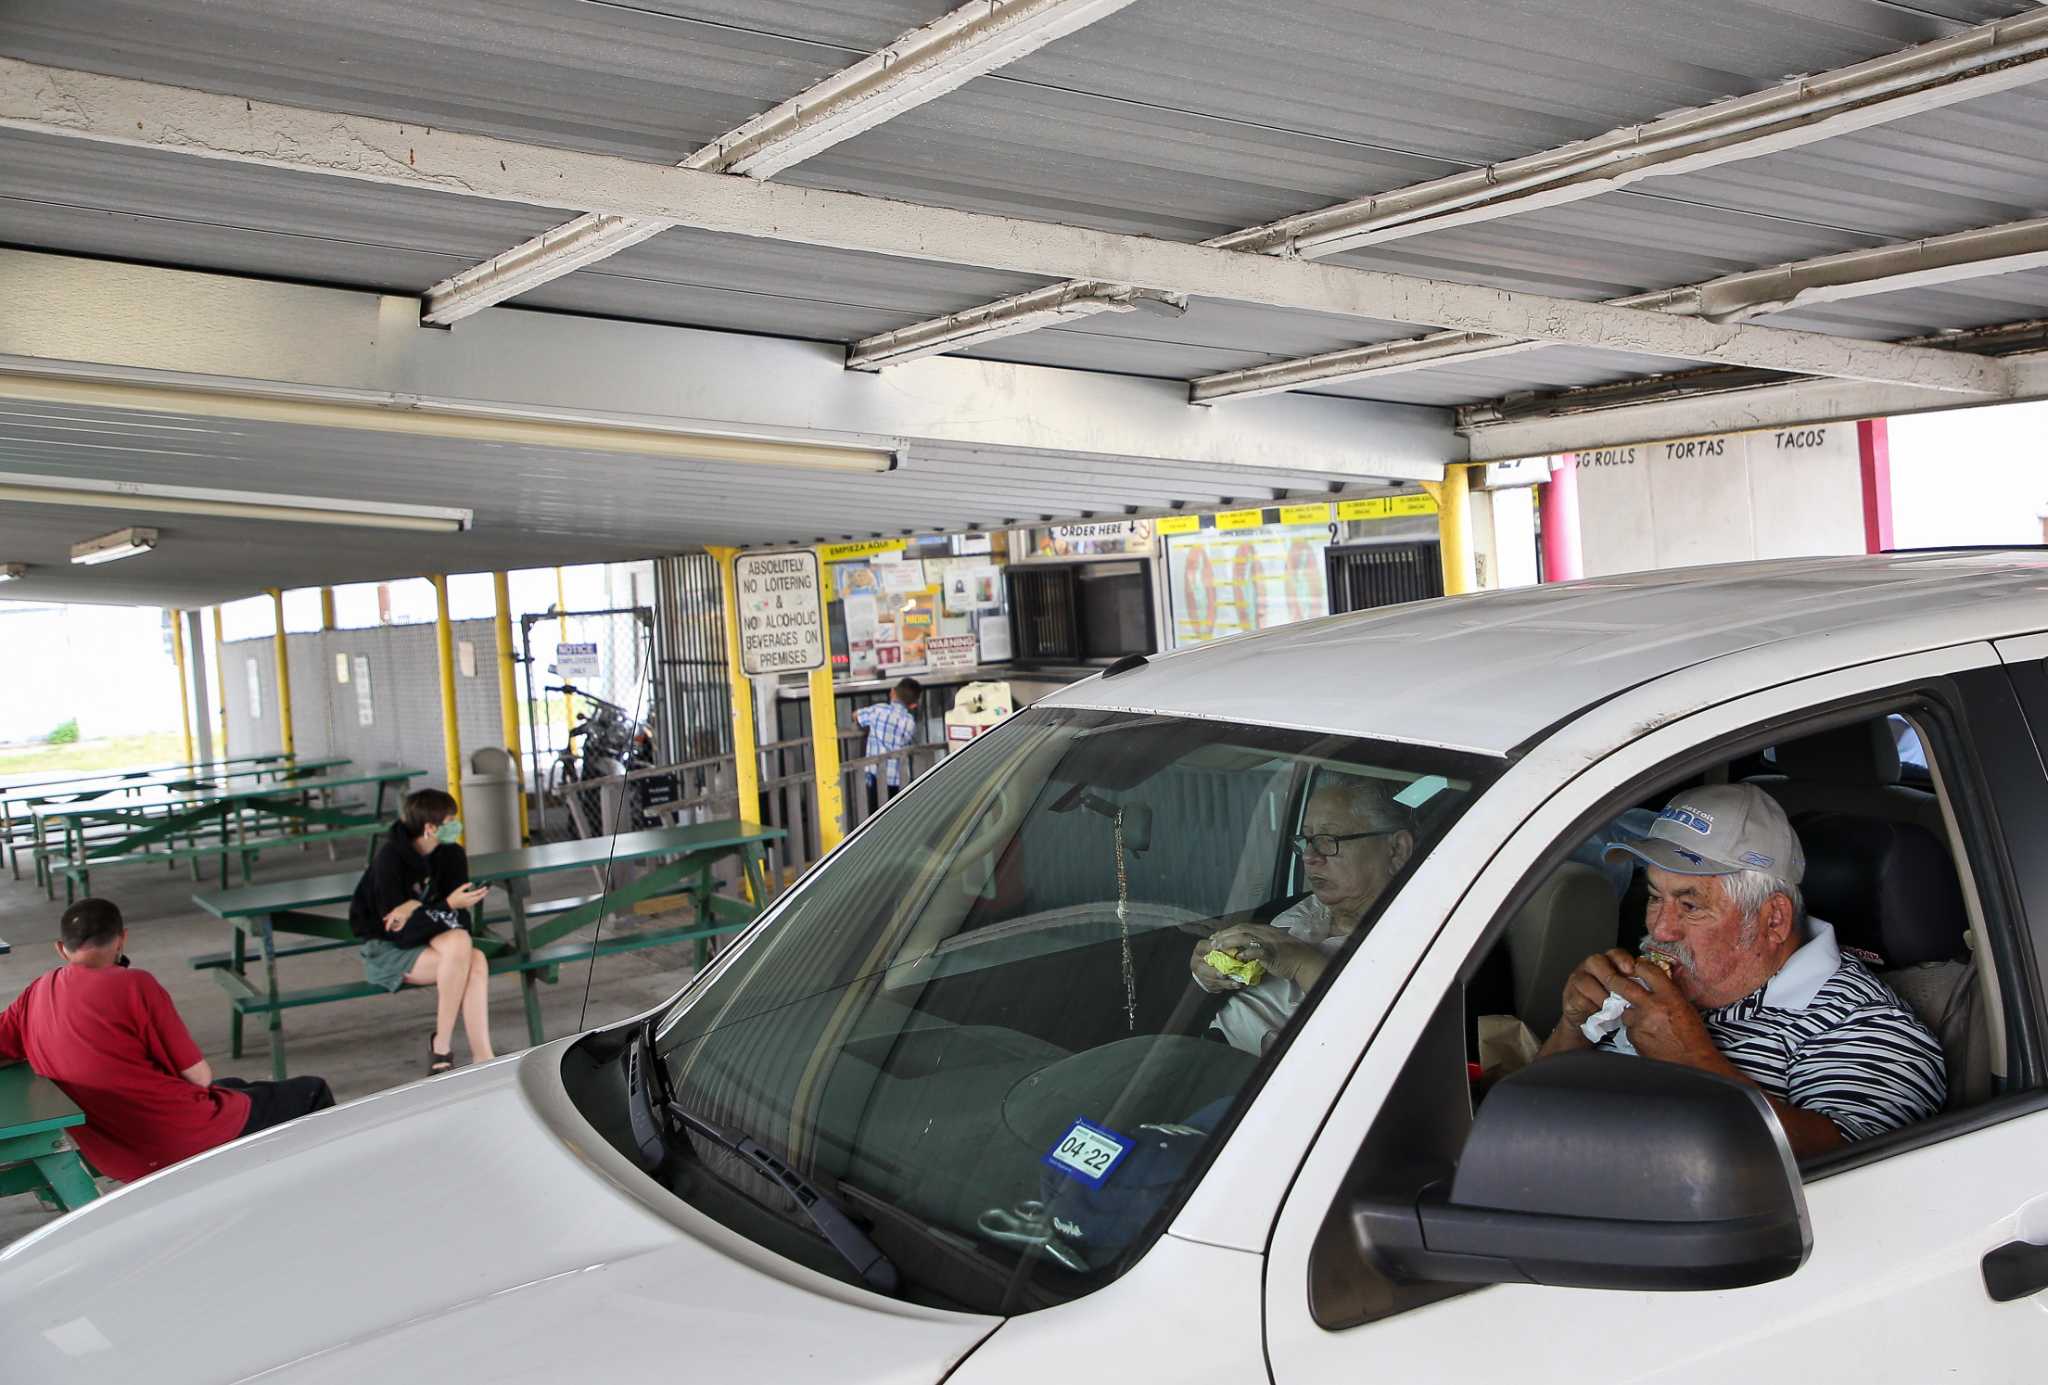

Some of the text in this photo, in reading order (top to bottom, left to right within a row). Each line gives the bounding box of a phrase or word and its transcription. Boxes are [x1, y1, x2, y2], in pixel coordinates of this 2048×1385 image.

[1775, 429, 1826, 448] TACOS
[1595, 448, 1635, 466] ROLLS
[1665, 439, 1724, 460] TORTAS
[1060, 523, 1121, 537] ORDER HERE
[1328, 522, 1340, 546] 2
[830, 544, 865, 555] EMPIEZA
[749, 559, 804, 575] ABSOLUTELY
[743, 575, 812, 593] NO LOITERING
[775, 595, 783, 609] &
[744, 610, 816, 630] NO ALCOHOLIC
[746, 629, 818, 650] BEVERAGES ON
[760, 649, 807, 668] PREMISES
